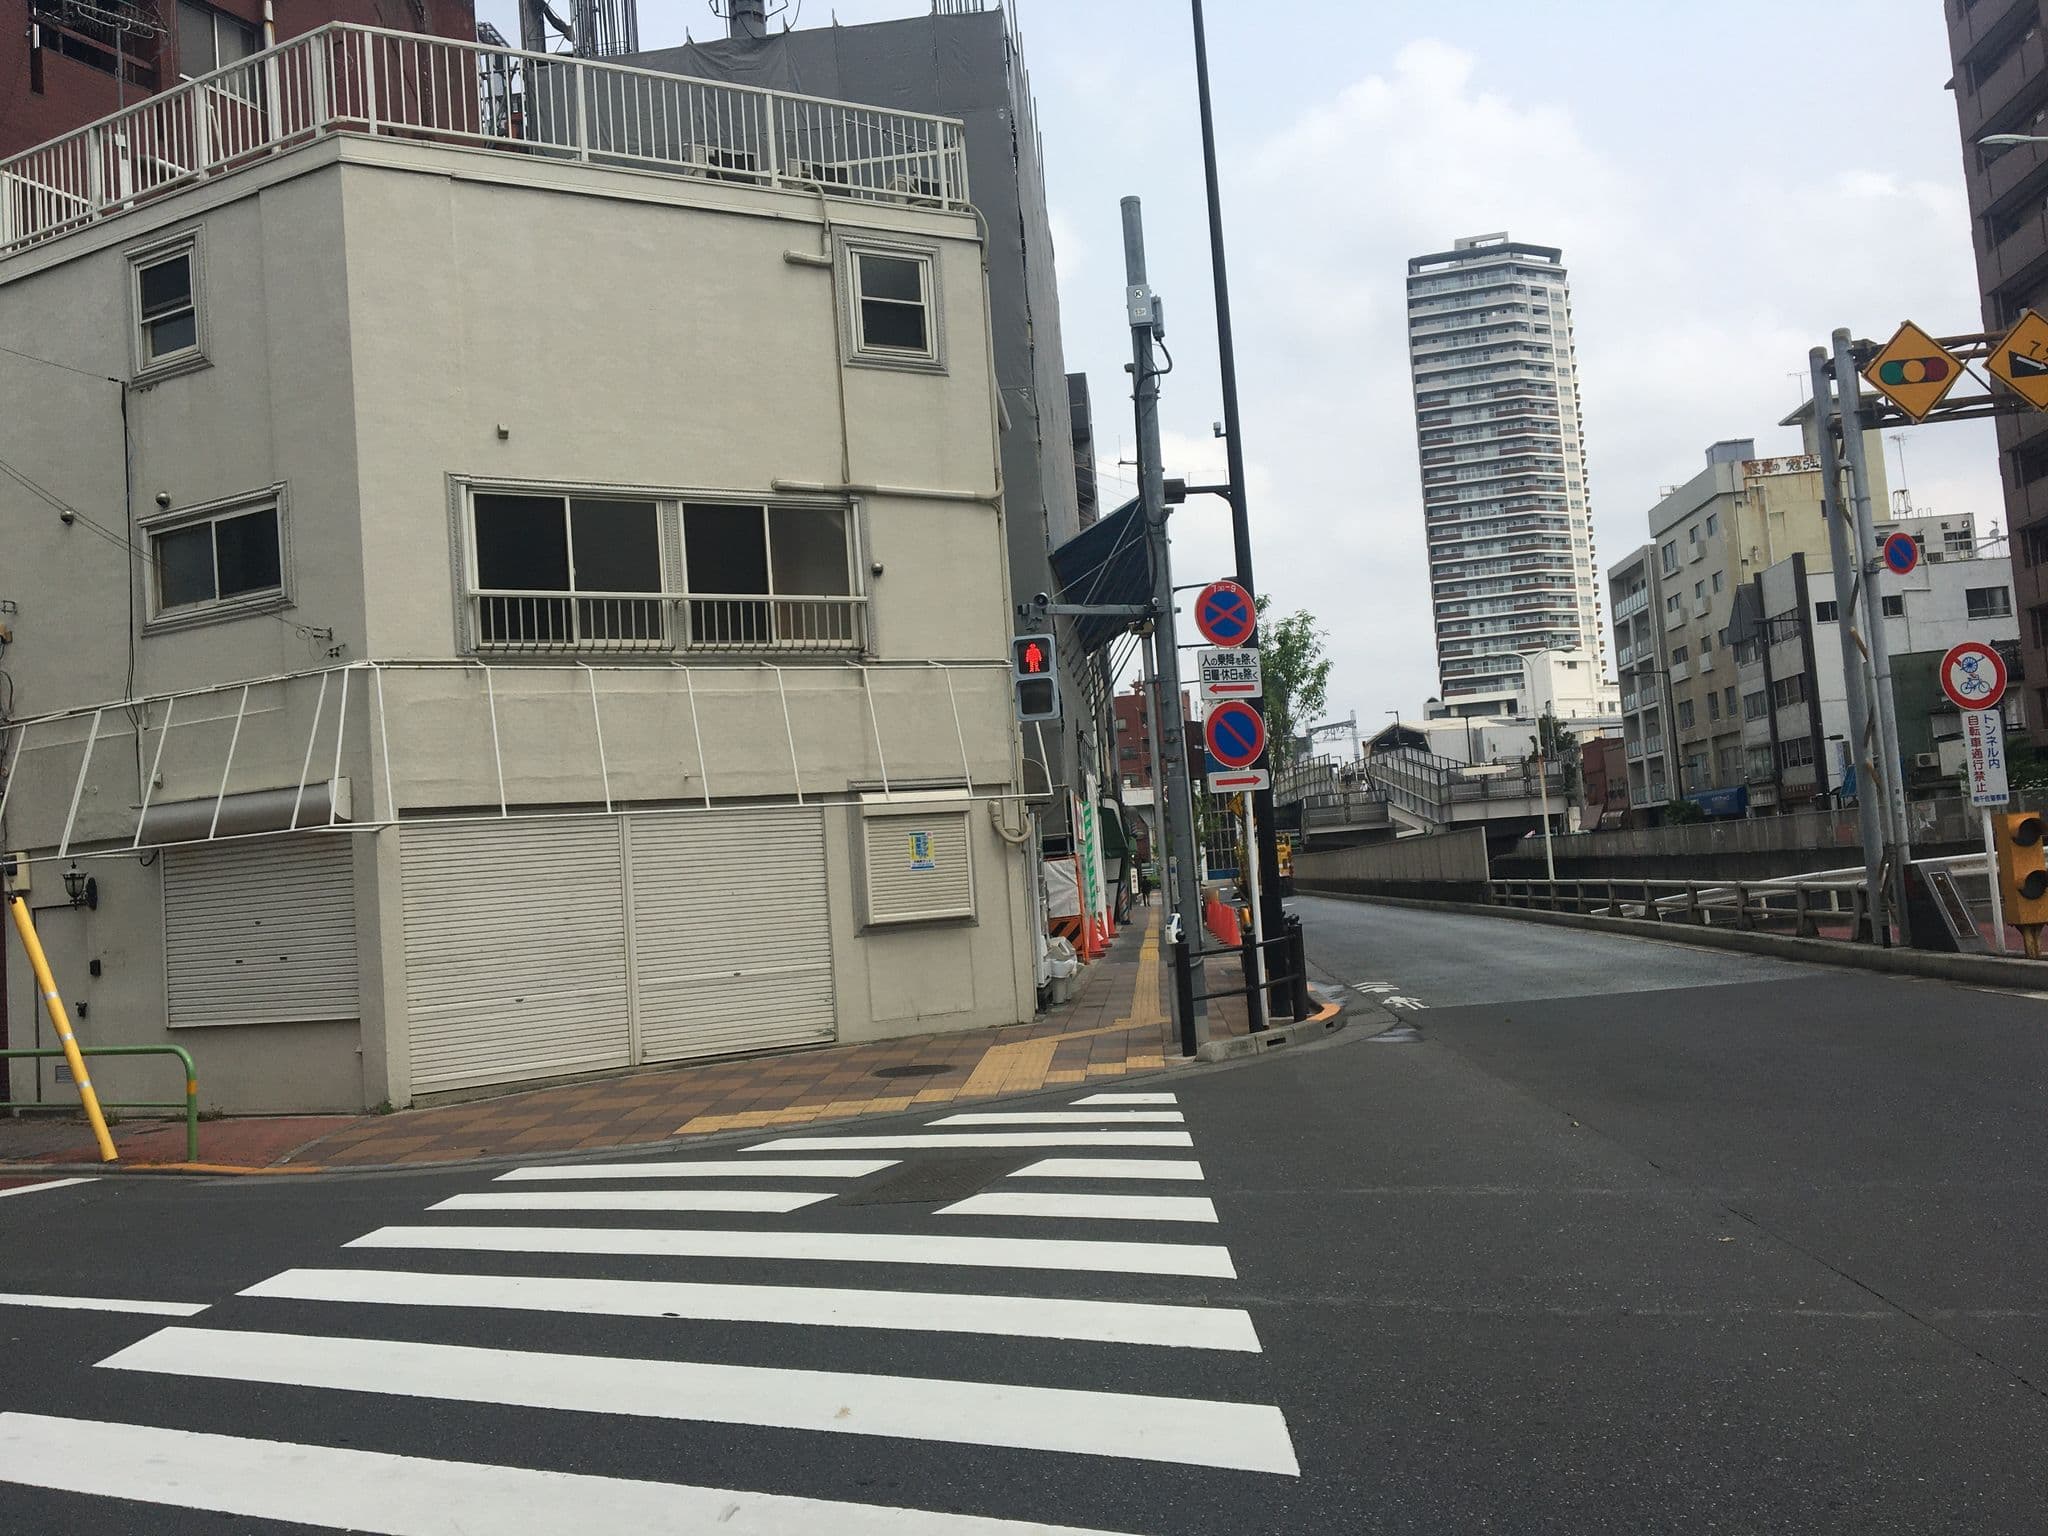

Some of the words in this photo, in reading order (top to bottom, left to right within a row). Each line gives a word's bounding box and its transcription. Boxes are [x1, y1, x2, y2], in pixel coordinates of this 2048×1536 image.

[1202, 653, 1257, 666] 人の乗降を除く
[1967, 715, 1988, 793] 自転車通行禁止
[1983, 714, 2001, 769] トンネル内
